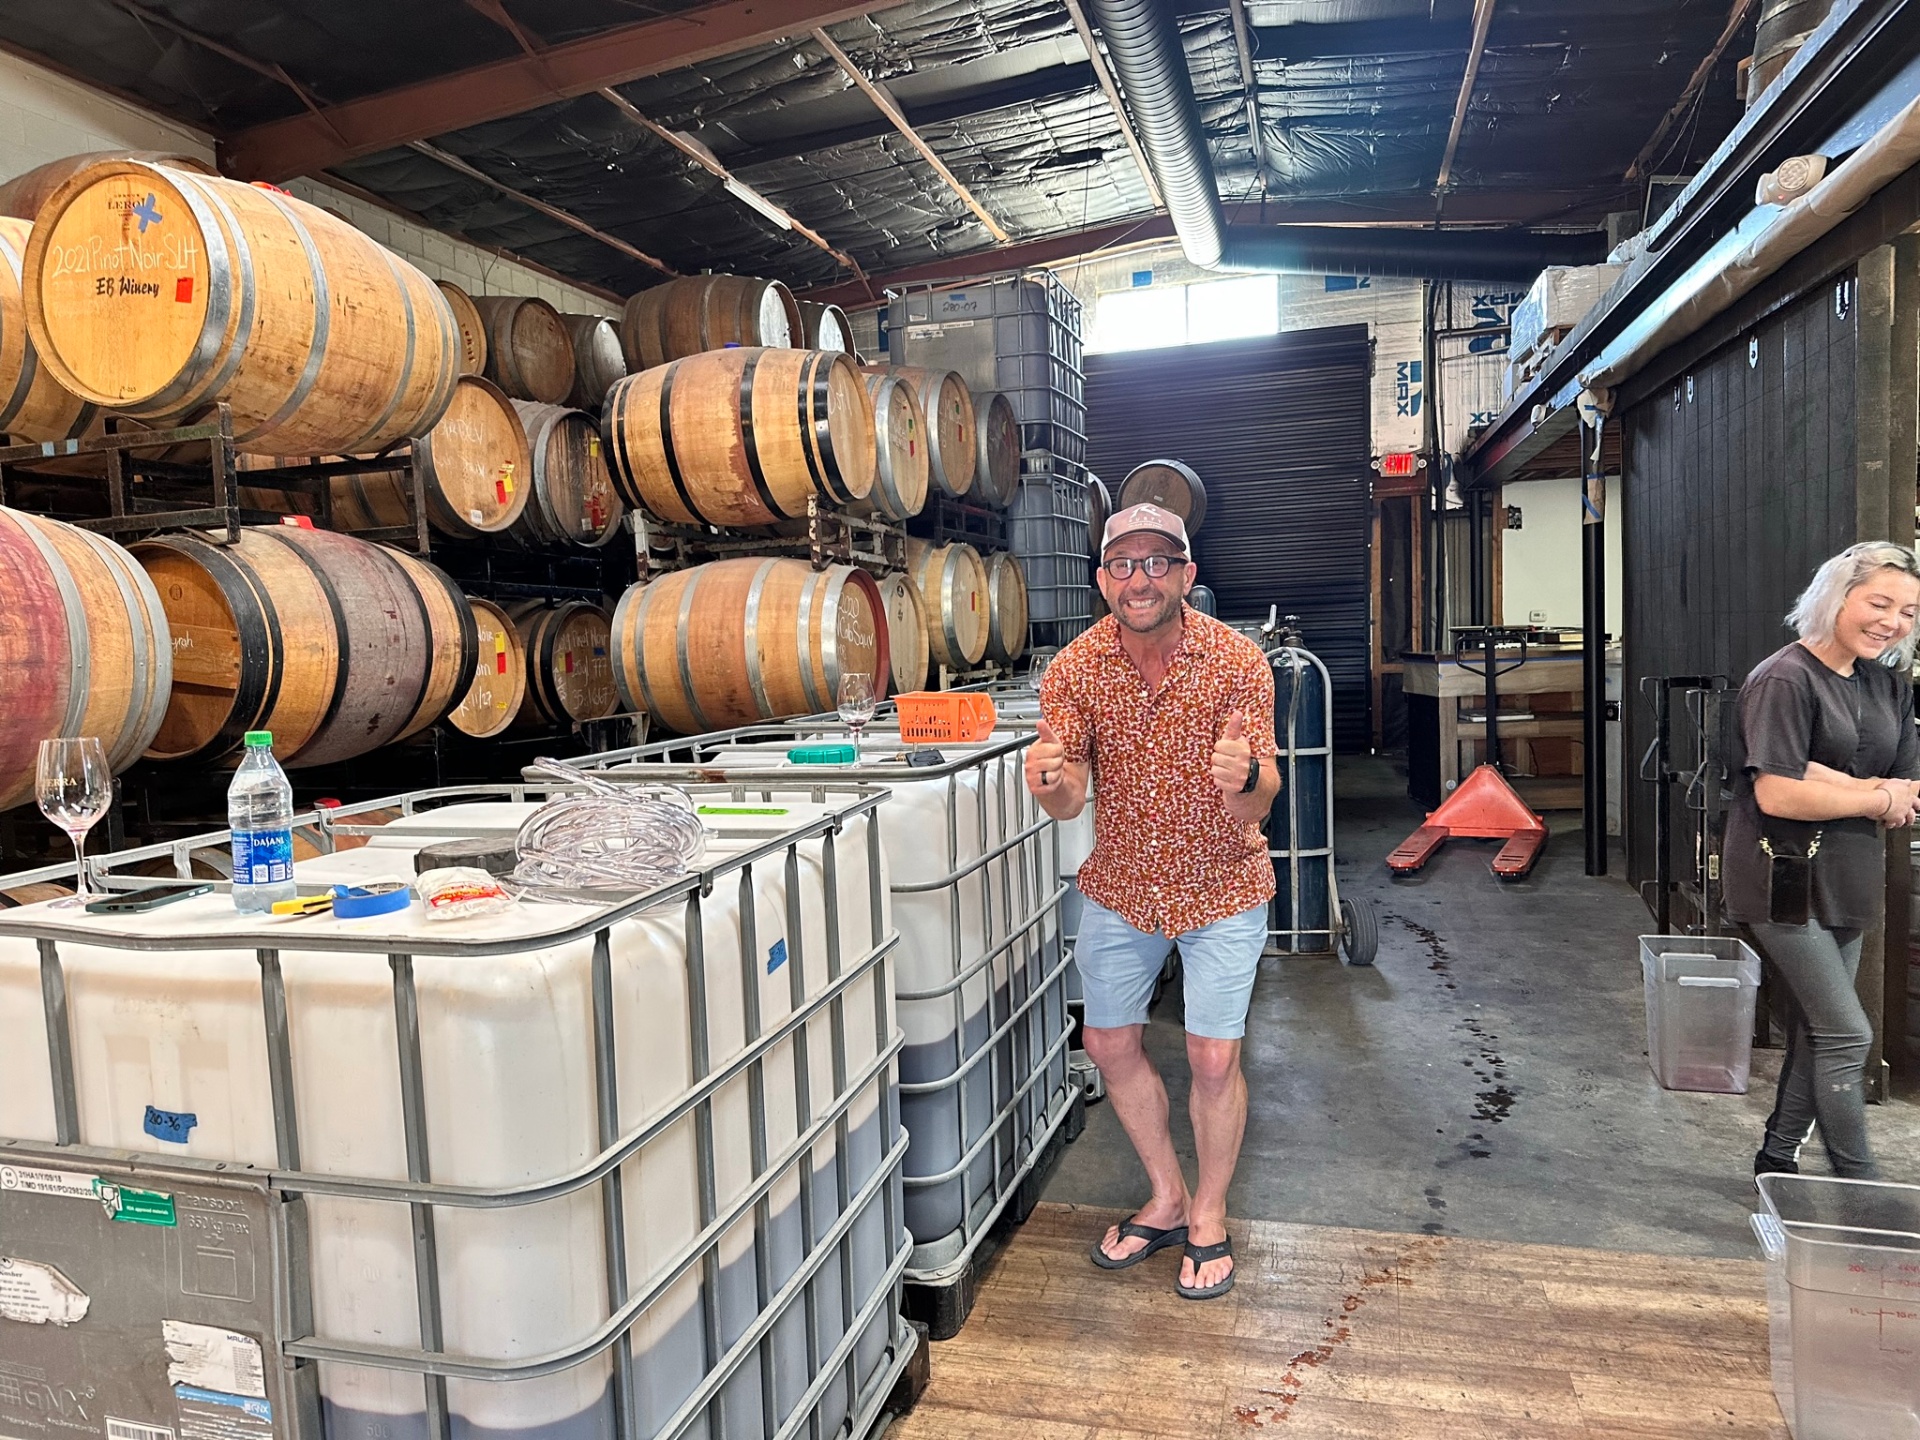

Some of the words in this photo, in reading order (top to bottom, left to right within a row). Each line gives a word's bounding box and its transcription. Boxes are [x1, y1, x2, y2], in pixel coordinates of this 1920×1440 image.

[52, 245, 90, 278] 2021
[88, 235, 130, 272] Pinot
[128, 235, 165, 272] Noir
[96, 276, 115, 298] EB
[119, 275, 160, 298] Winery
[1396, 361, 1409, 417] MAX
[1386, 454, 1413, 474] EXIT
[171, 629, 194, 656] yrah
[253, 836, 285, 848] DASANI
